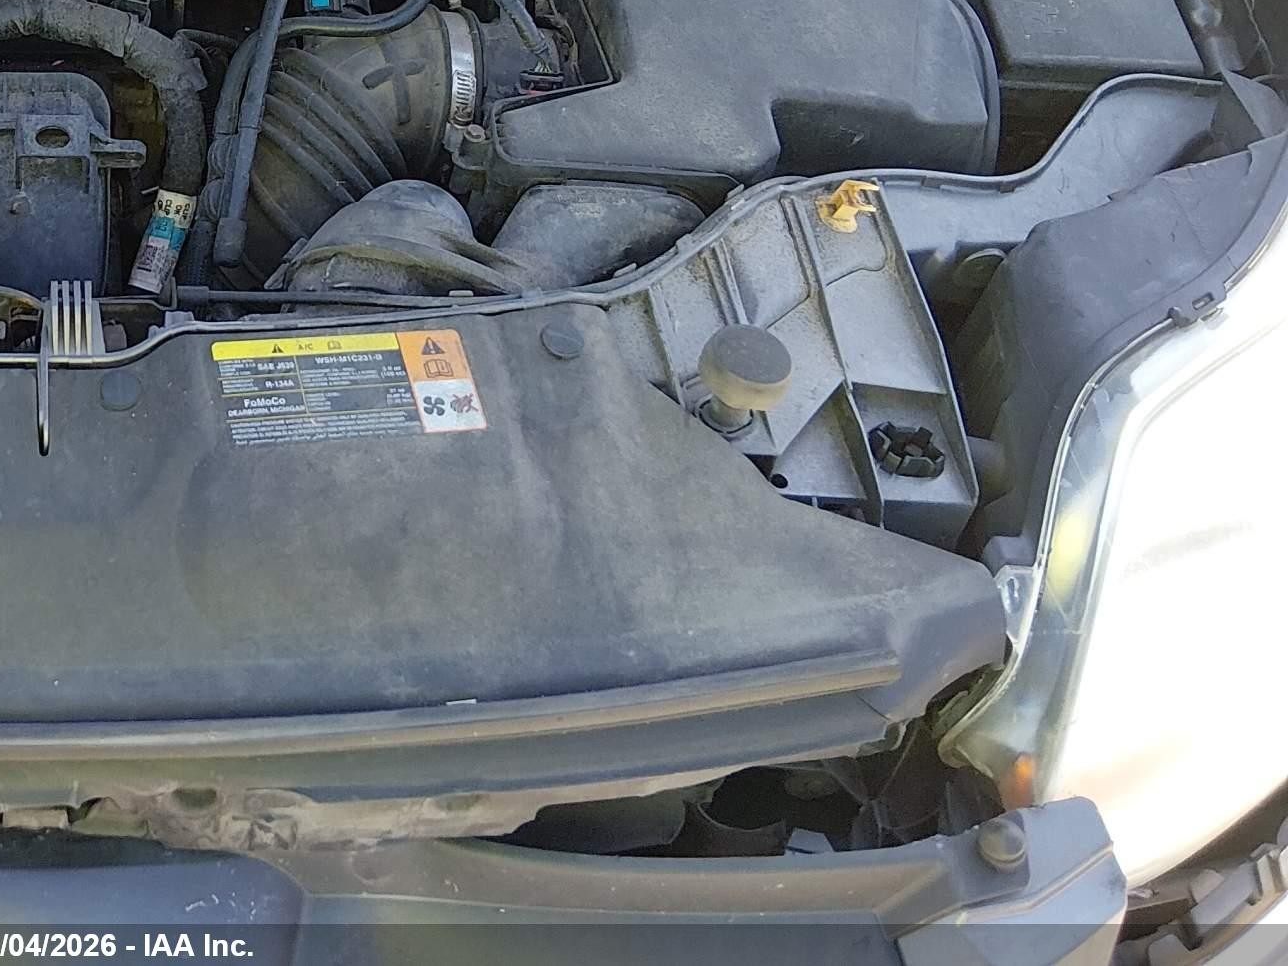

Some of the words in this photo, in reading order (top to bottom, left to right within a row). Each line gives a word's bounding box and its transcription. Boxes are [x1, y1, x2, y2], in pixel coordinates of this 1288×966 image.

[297, 343, 314, 351] A/C
[265, 379, 295, 389] R-134A
[243, 396, 286, 408] FoMoCo
